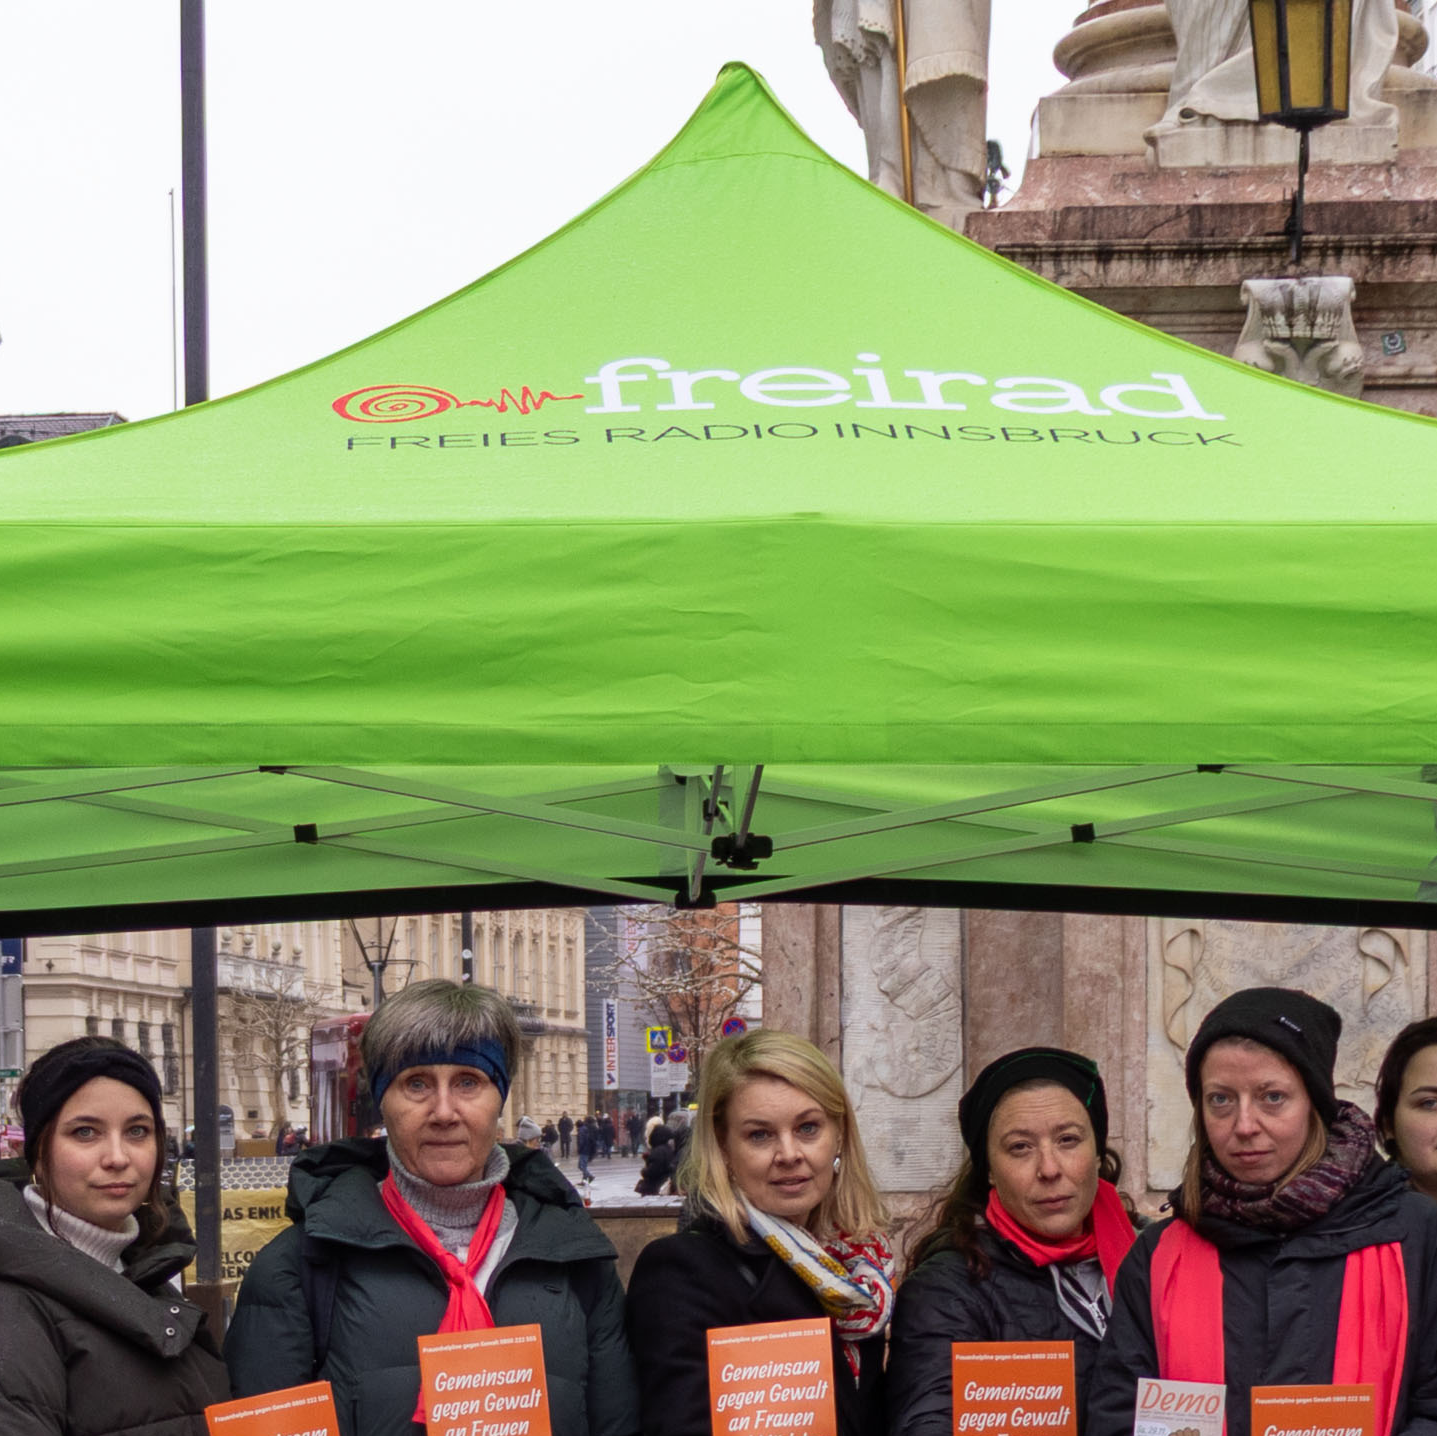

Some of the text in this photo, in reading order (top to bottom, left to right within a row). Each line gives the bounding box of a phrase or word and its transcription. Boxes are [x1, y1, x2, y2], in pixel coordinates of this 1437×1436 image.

[584, 353, 1226, 420] freirad
[346, 422, 1243, 450] FREIES RADIO INNSBRUCK
[605, 1003, 616, 1072] INTERSPORT
[248, 1205, 282, 1220] ENK
[434, 1368, 532, 1391] Gemeinsam
[721, 1360, 819, 1382] Gemeinsam
[716, 1380, 827, 1412] gegen Gewalt
[964, 1380, 1063, 1400] Gemeinsam
[1140, 1382, 1221, 1415] Demo
[431, 1388, 541, 1422] gegen Gewalt
[958, 1405, 1070, 1431] gegen Gewalt
[728, 1410, 814, 1431] an Frauen
